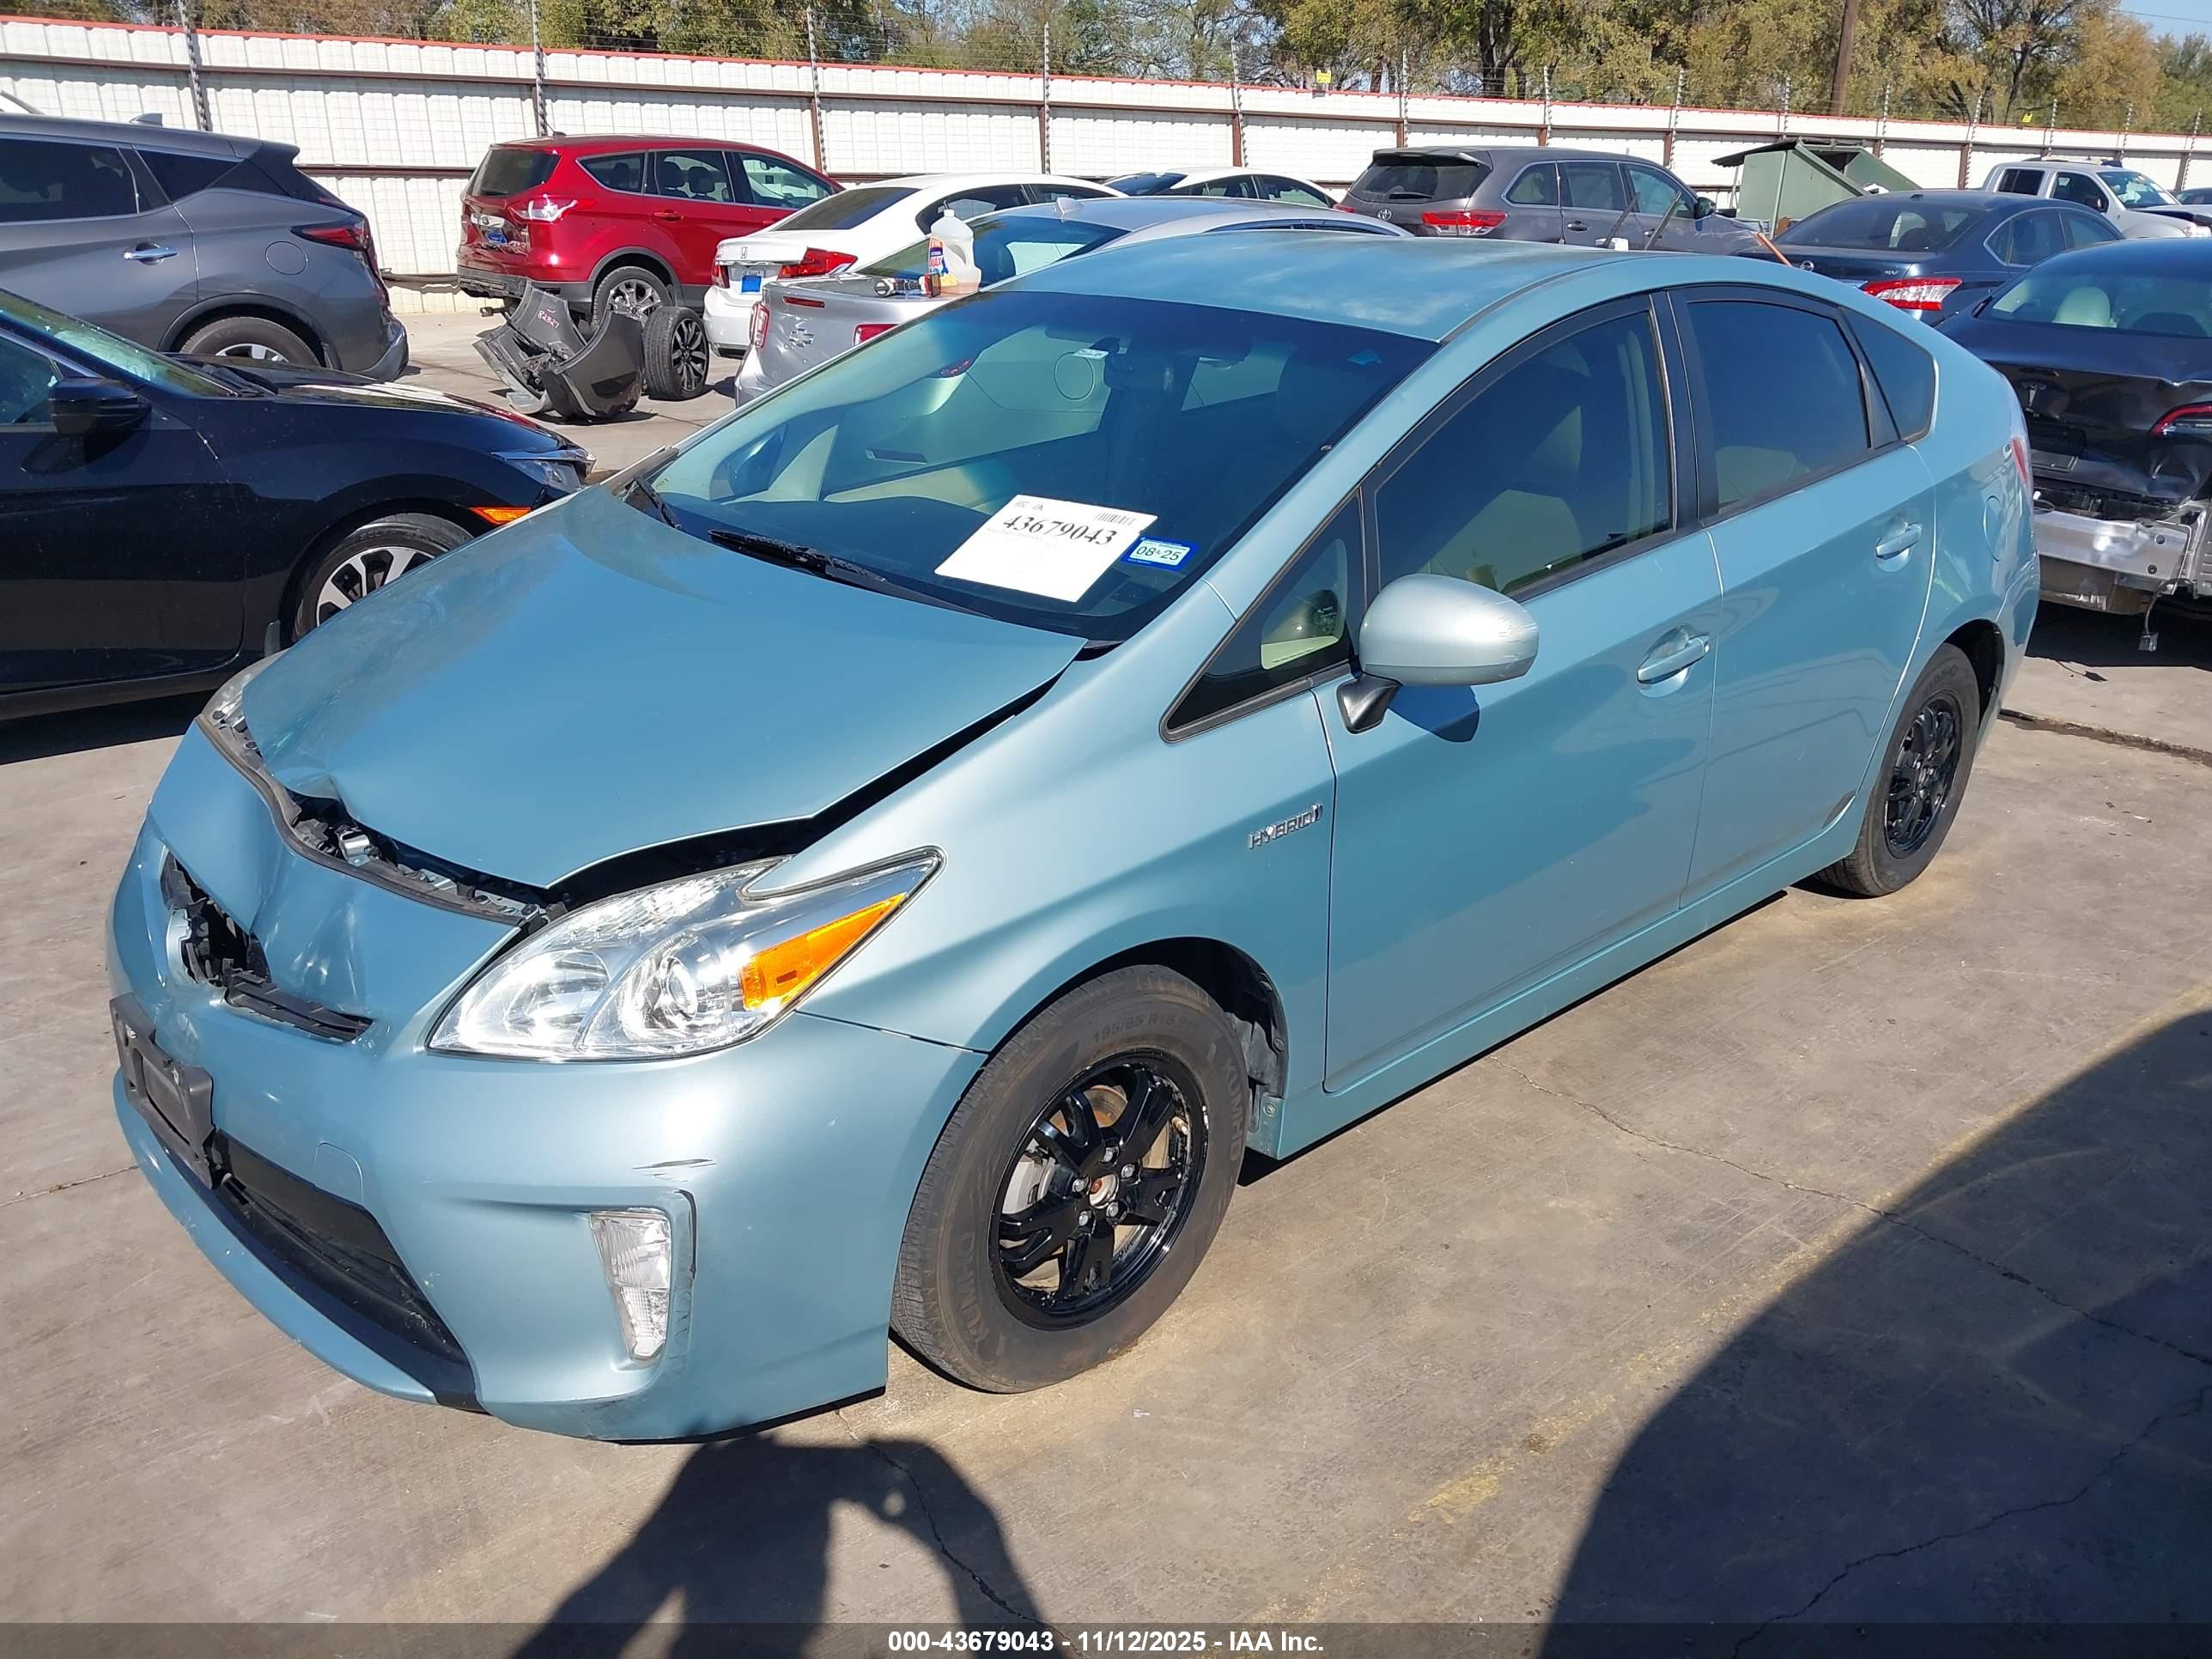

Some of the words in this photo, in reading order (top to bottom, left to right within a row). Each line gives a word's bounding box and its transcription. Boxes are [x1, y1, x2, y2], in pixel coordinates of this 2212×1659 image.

[1003, 515, 1117, 545] 43679043
[1136, 546, 1157, 556] 08
[1160, 550, 1182, 561] 25
[1249, 808, 1315, 850] HYBRID
